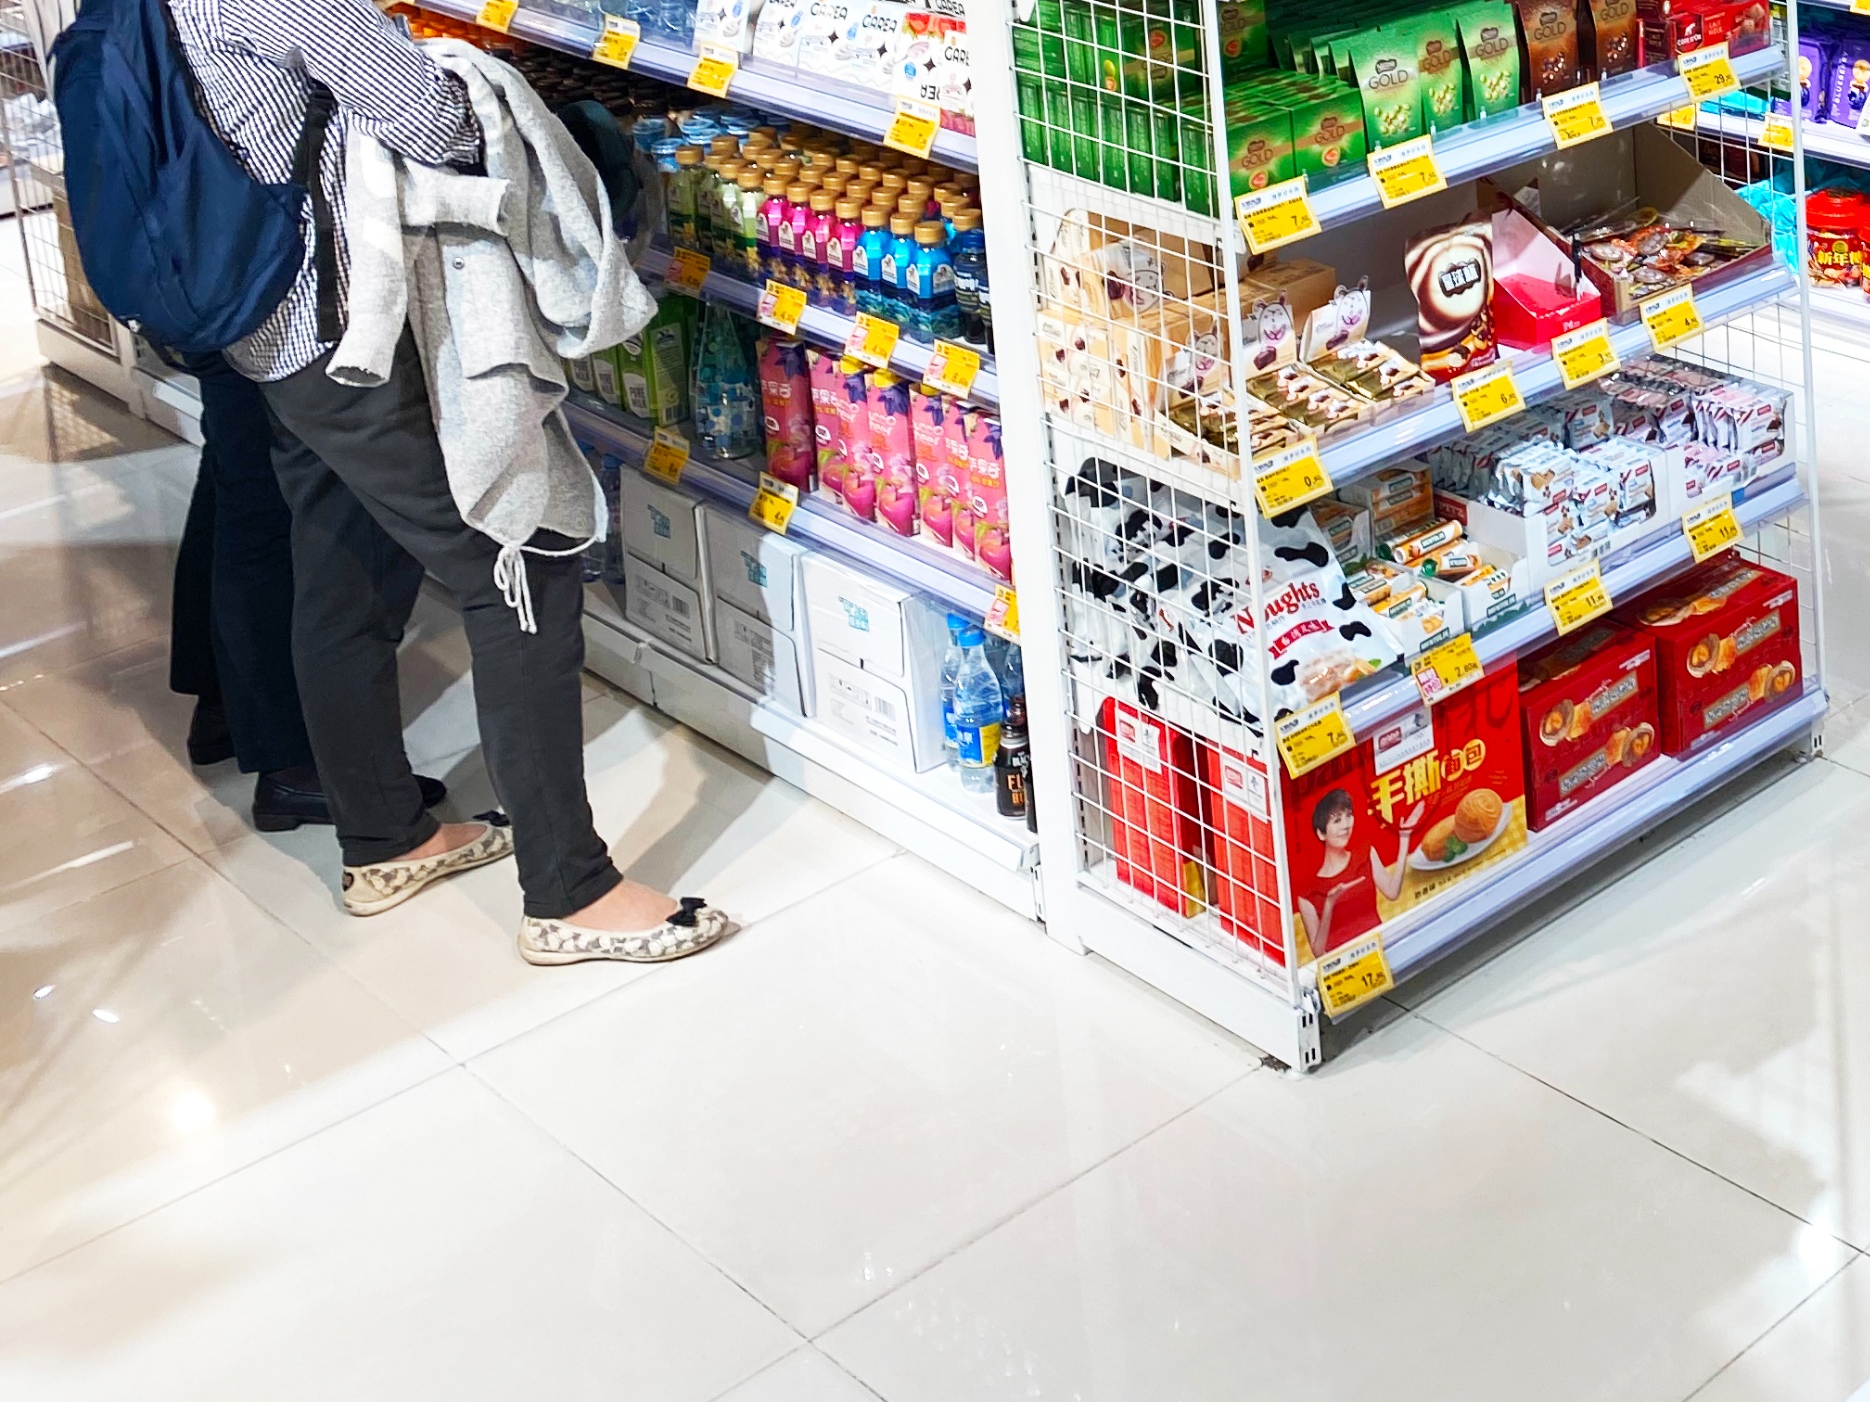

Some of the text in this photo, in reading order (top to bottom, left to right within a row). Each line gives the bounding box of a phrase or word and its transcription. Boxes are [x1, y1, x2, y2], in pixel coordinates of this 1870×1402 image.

[810, 1, 848, 22] GAREA
[1600, 2, 1629, 23] GOLD
[862, 13, 898, 35] GAREA
[1534, 22, 1567, 42] GOLD
[1475, 37, 1509, 59] GOLD
[1423, 50, 1451, 72] GOLD
[1369, 69, 1409, 91] GOLD
[1314, 124, 1346, 145] GOLD
[1241, 148, 1274, 171] GOLD
[1368, 739, 1486, 824] 手撕面包
